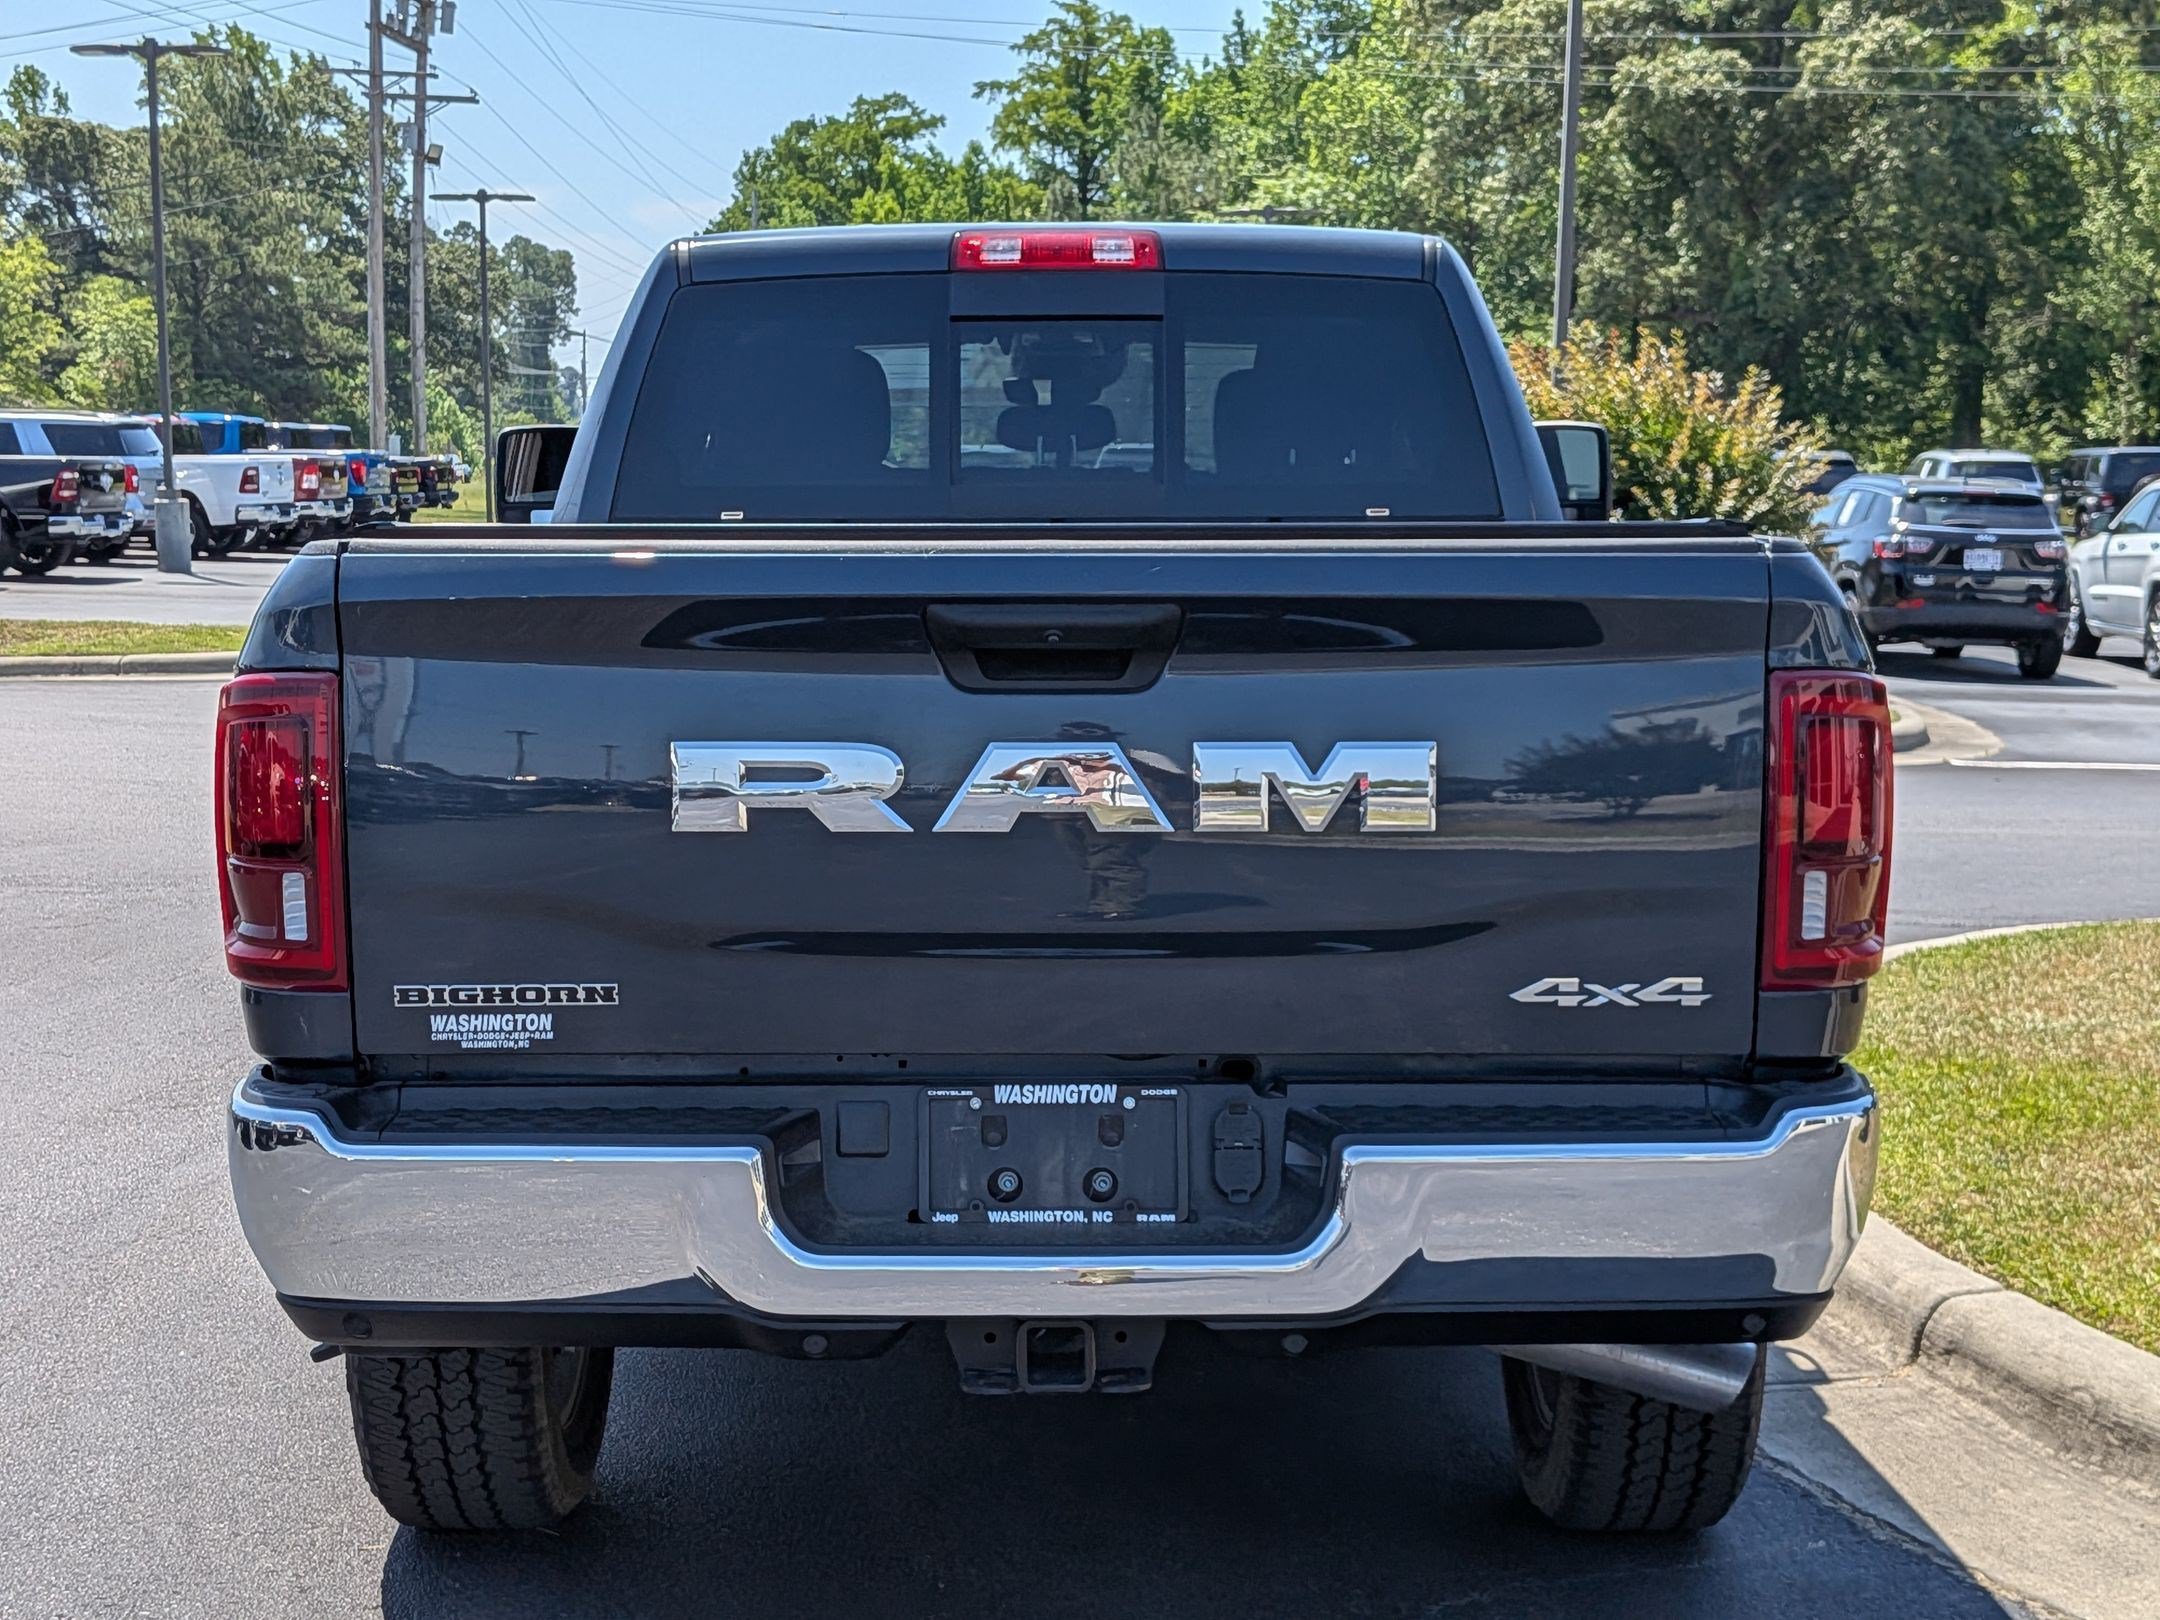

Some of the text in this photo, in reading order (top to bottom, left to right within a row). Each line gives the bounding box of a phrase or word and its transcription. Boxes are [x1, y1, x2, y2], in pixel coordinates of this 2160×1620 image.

[670, 740, 1437, 833] RAM
[394, 983, 619, 1008] BIGHORN
[1508, 976, 1713, 1007] 4x4
[430, 1013, 553, 1032] WASHINGTON
[993, 1084, 1118, 1104] WASHINGTON
[931, 1211, 959, 1223] Jeep
[987, 1210, 1113, 1224] WASHINGTON, NC
[1136, 1213, 1176, 1223] RAM
